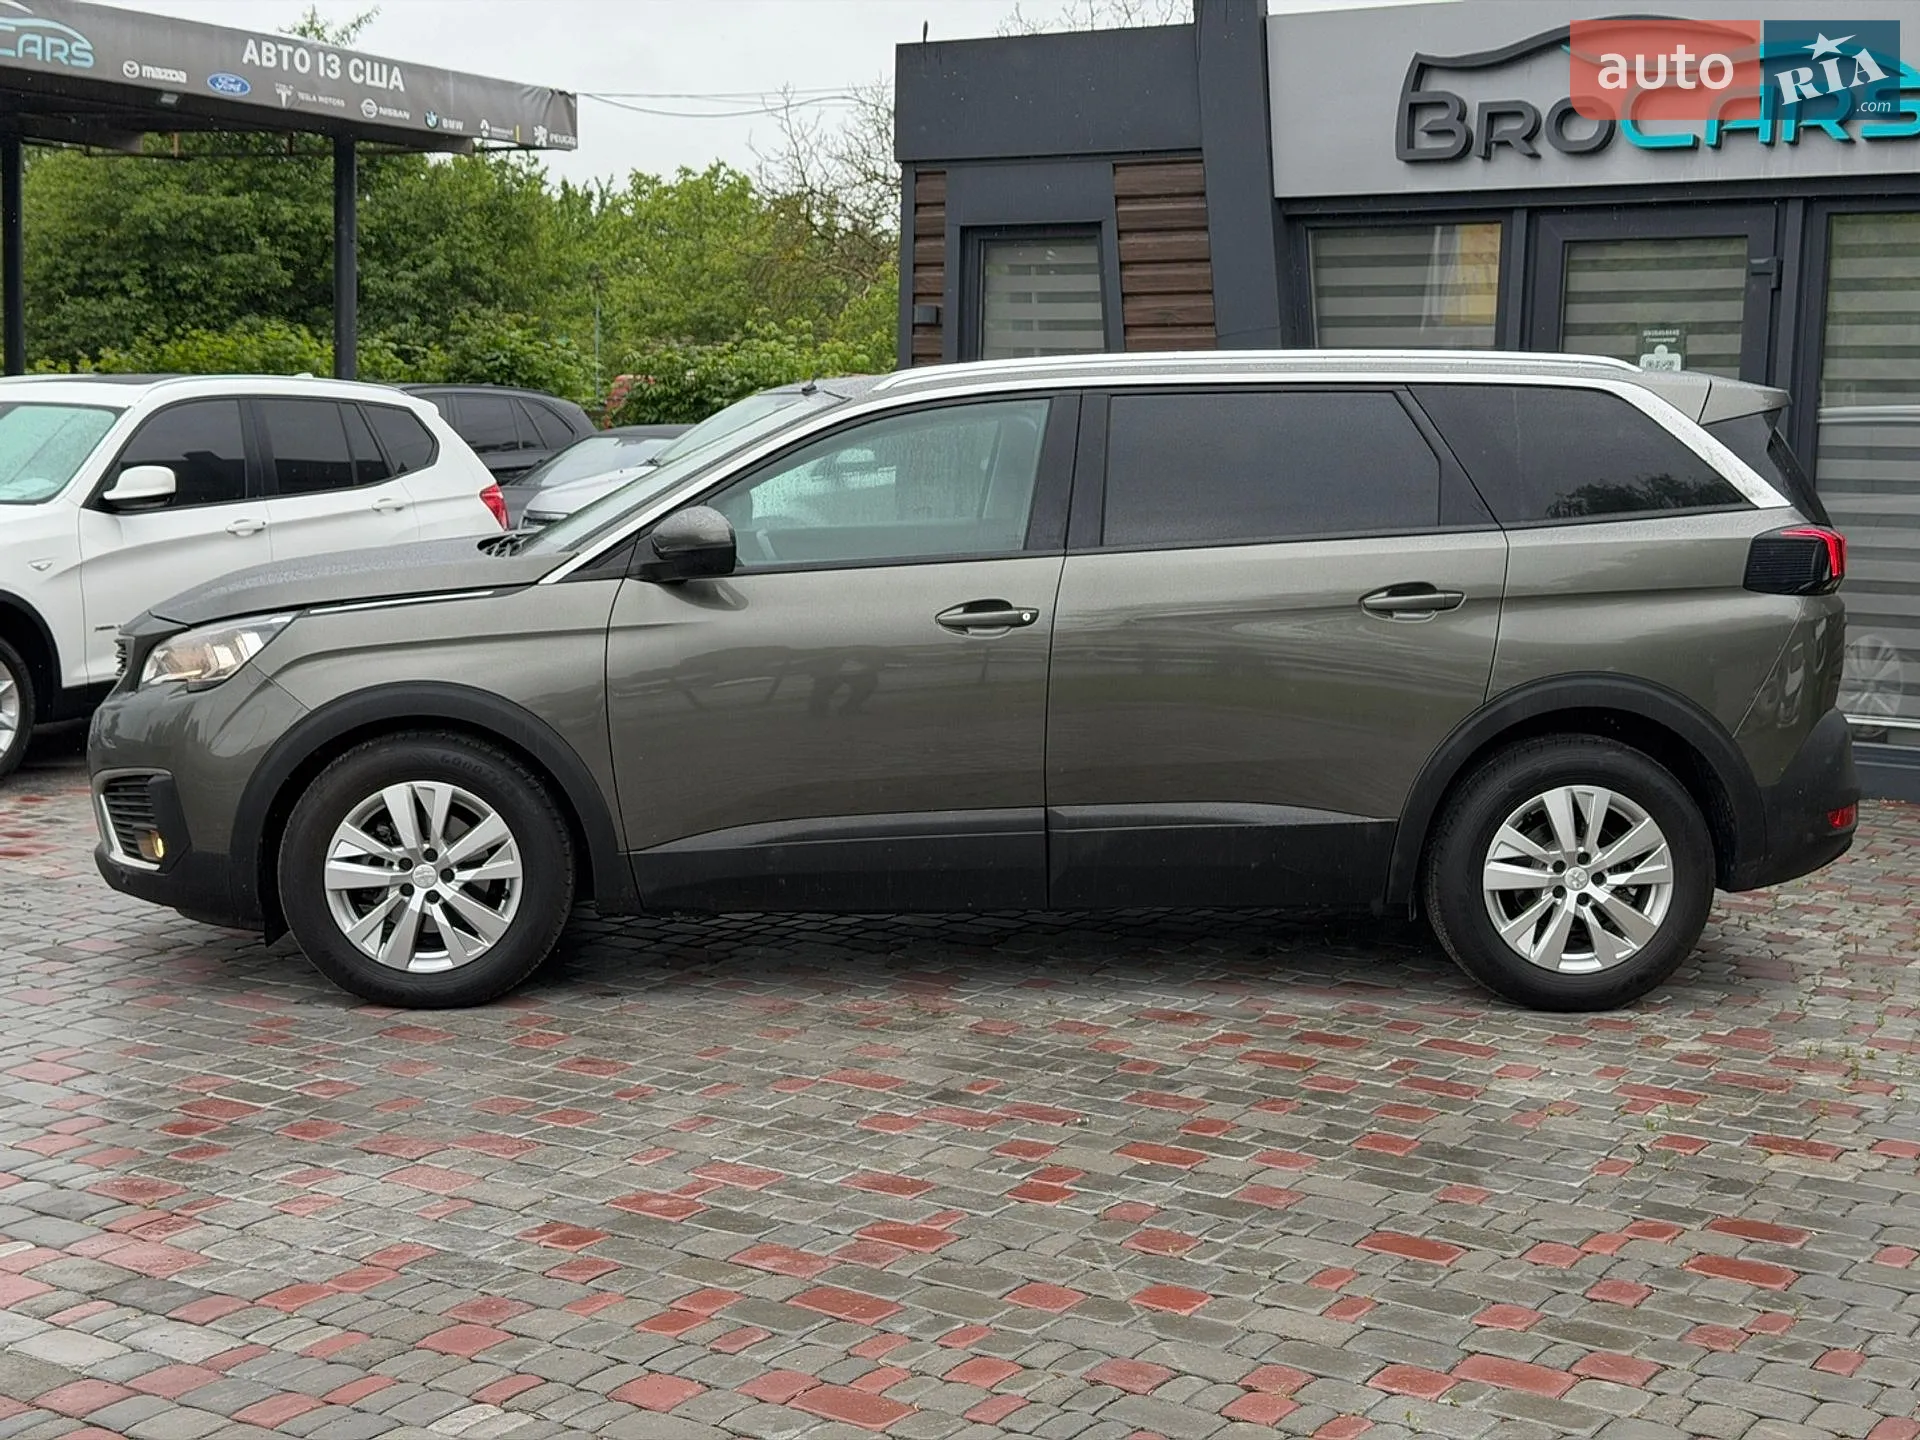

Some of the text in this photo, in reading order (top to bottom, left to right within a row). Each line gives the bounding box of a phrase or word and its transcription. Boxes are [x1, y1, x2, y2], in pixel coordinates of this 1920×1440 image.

[241, 38, 311, 74] АВТО
[348, 58, 405, 92] США
[442, 118, 464, 131] BMW
